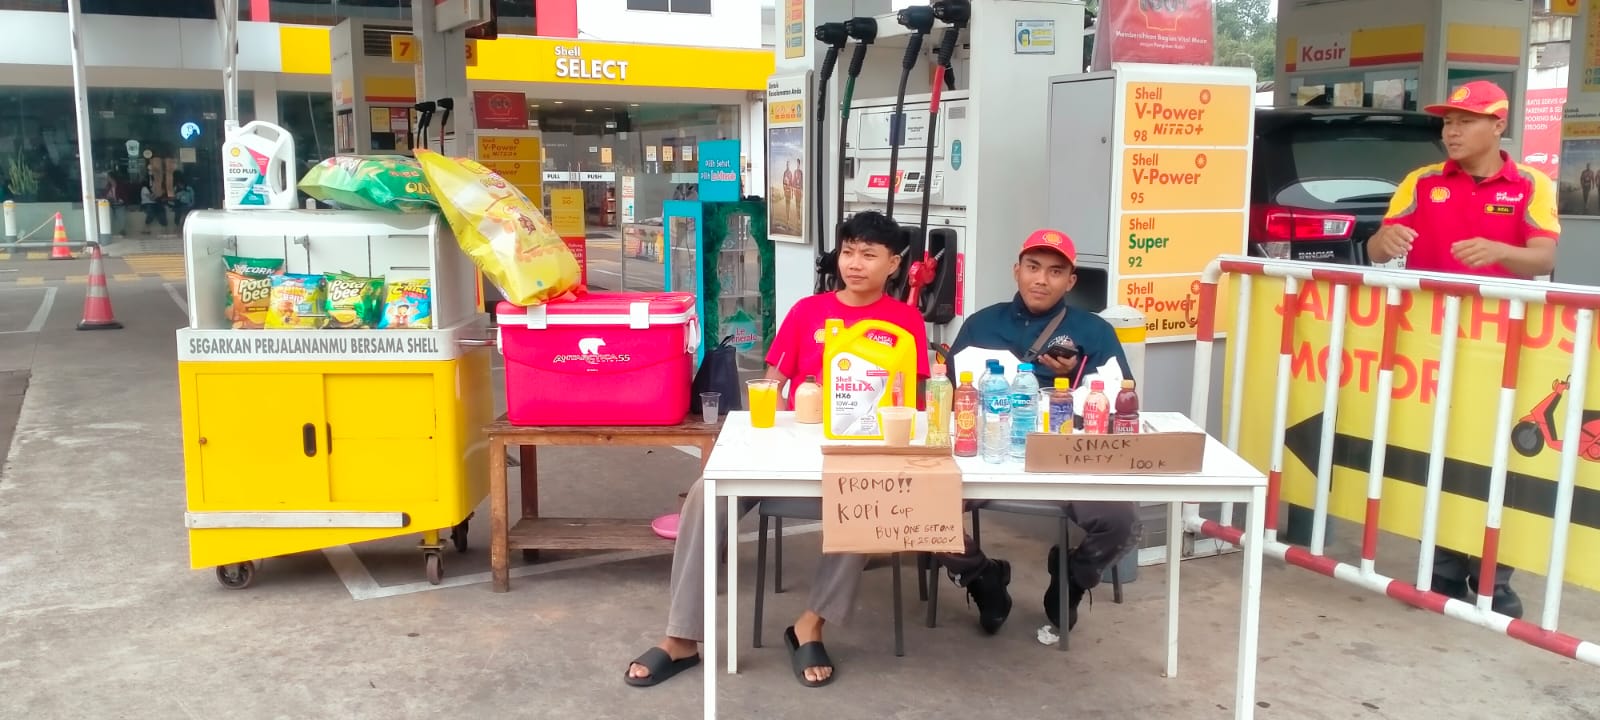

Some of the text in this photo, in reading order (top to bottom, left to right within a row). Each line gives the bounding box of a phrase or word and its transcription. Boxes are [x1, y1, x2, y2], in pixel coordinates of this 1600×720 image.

[400, 42, 410, 57] 7
[555, 46, 580, 57] Shell
[1302, 42, 1345, 62] Kasir
[556, 58, 628, 80] SELECT
[1135, 86, 1162, 100] Shell
[1135, 103, 1204, 120] V-Power
[1133, 130, 1148, 142] 98
[1132, 153, 1158, 166] Shell
[1132, 168, 1201, 184] V-Power
[1130, 192, 1144, 203] 95
[1129, 217, 1155, 230] Shell
[1128, 233, 1169, 253] Super
[1128, 256, 1142, 267] 92
[239, 278, 271, 294] Pota
[331, 280, 367, 291] Pota
[1127, 282, 1153, 295] Shell
[241, 287, 269, 303] bee
[332, 288, 361, 301] bee
[1127, 297, 1197, 312] V-Power
[1162, 319, 1186, 330] Euro
[190, 337, 438, 354] SEGARKAN PERJALANANMU BERSAMA SHELL
[1289, 340, 1445, 403] MOTOR
[835, 383, 875, 391] HELIX
[838, 476, 912, 495] PROMO!!
[876, 526, 899, 540] BUY
[903, 525, 920, 534] ONE
